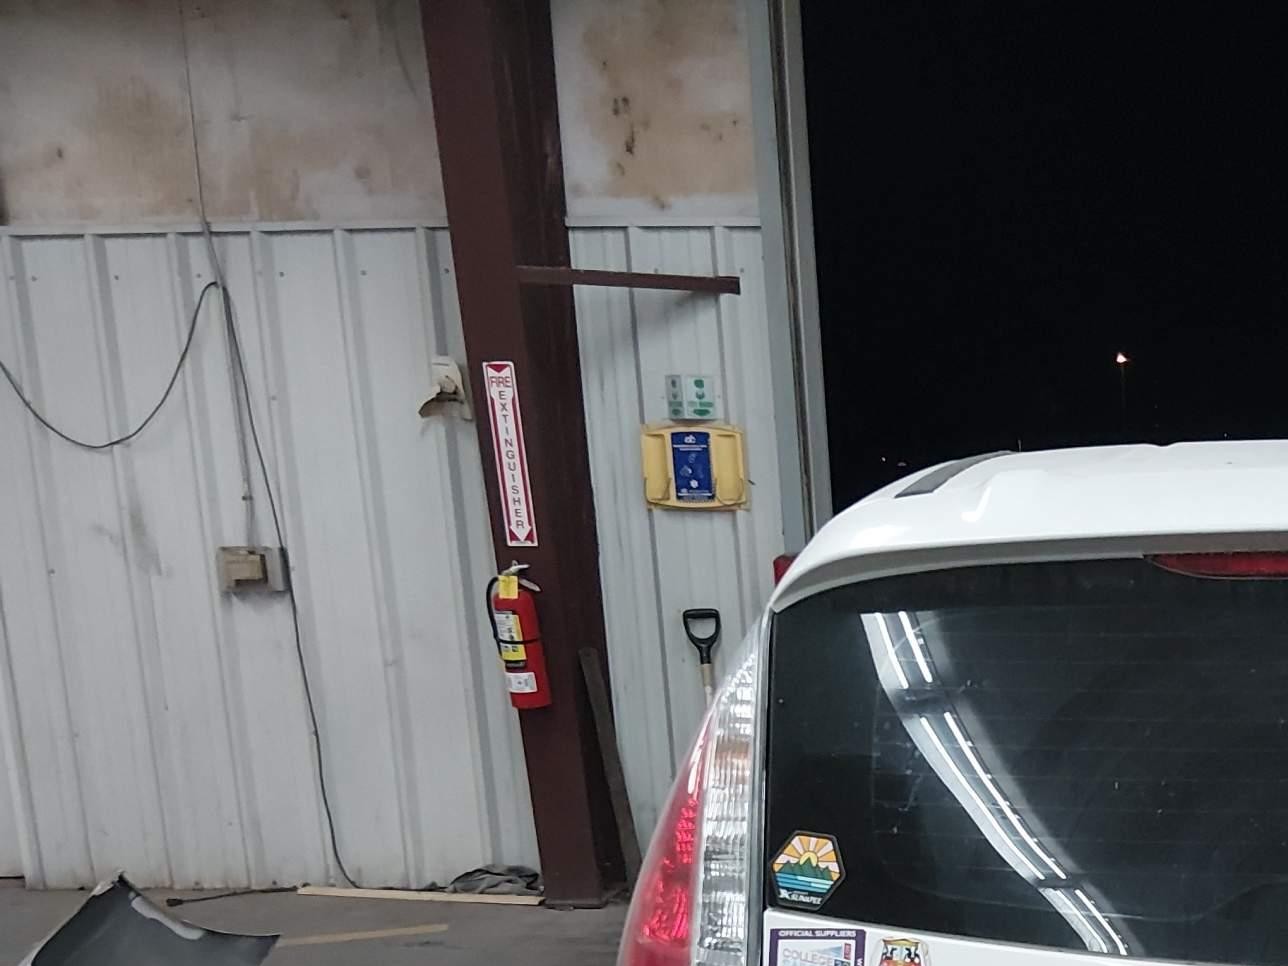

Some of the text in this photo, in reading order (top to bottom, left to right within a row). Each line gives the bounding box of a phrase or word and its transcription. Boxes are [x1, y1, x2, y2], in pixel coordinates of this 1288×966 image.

[489, 375, 512, 389] FIRE
[498, 390, 525, 529] EXTINGUISHER
[815, 930, 857, 938] SUPPLIERS
